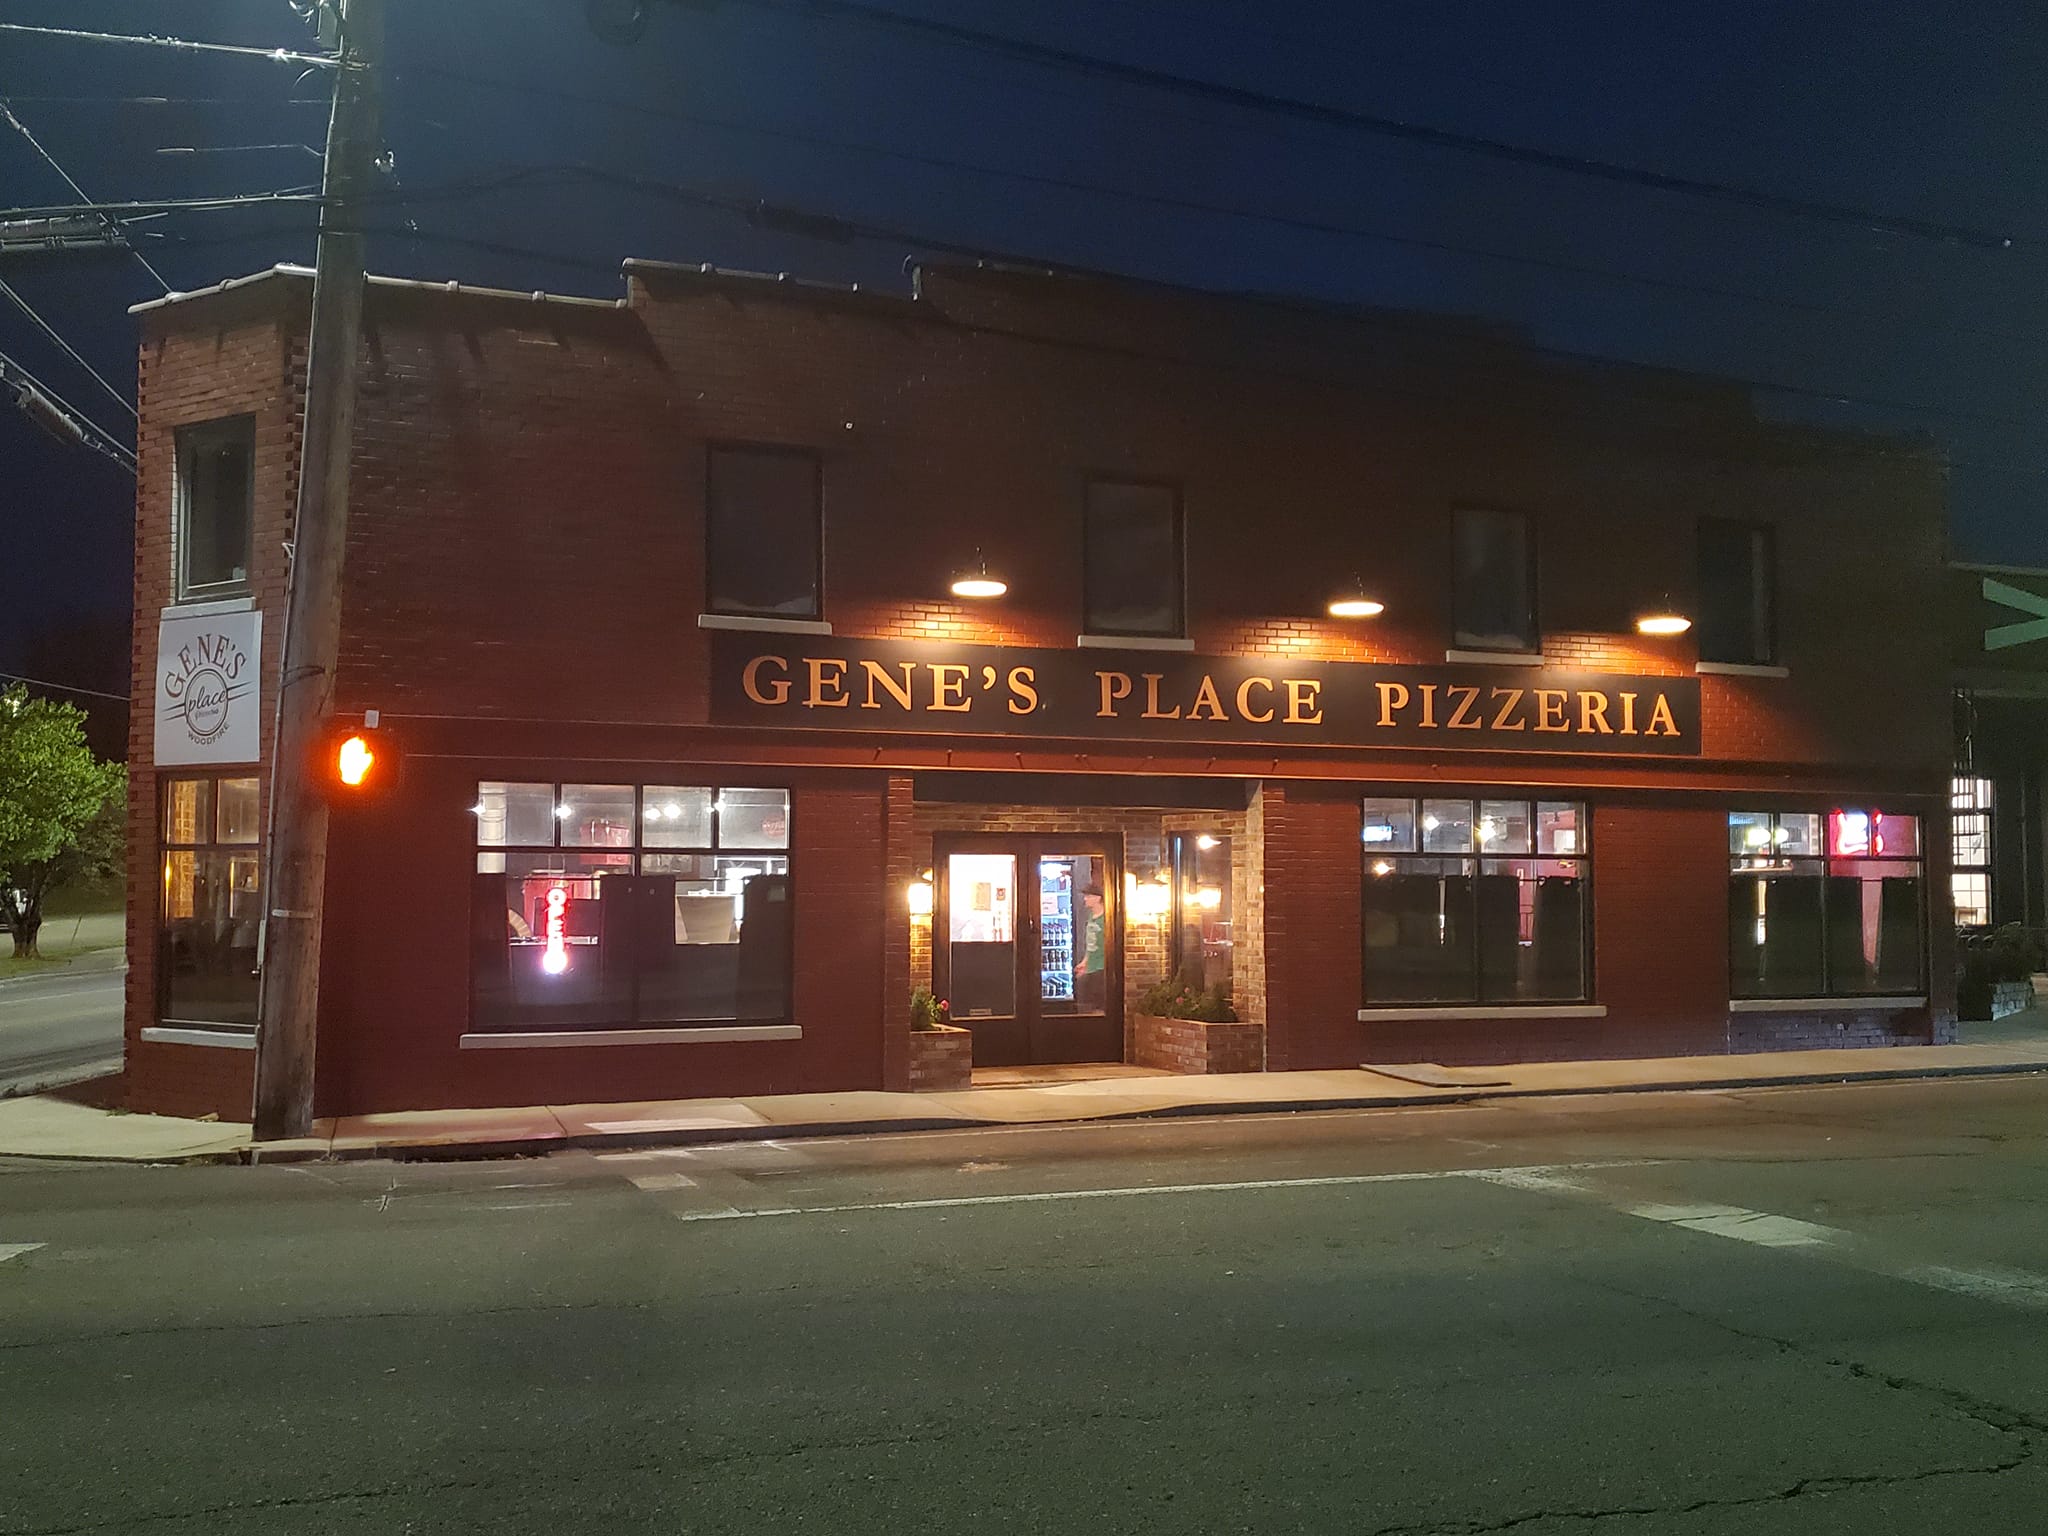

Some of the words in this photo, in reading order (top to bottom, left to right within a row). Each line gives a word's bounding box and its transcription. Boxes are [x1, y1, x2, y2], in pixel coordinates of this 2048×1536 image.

[165, 633, 247, 698] GENE'S
[187, 685, 227, 719] place
[742, 655, 1040, 715] GENE'S
[1095, 671, 1323, 725] PLACE
[1374, 681, 1681, 736] PIZZERIA
[187, 722, 231, 745] WOODFIRE
